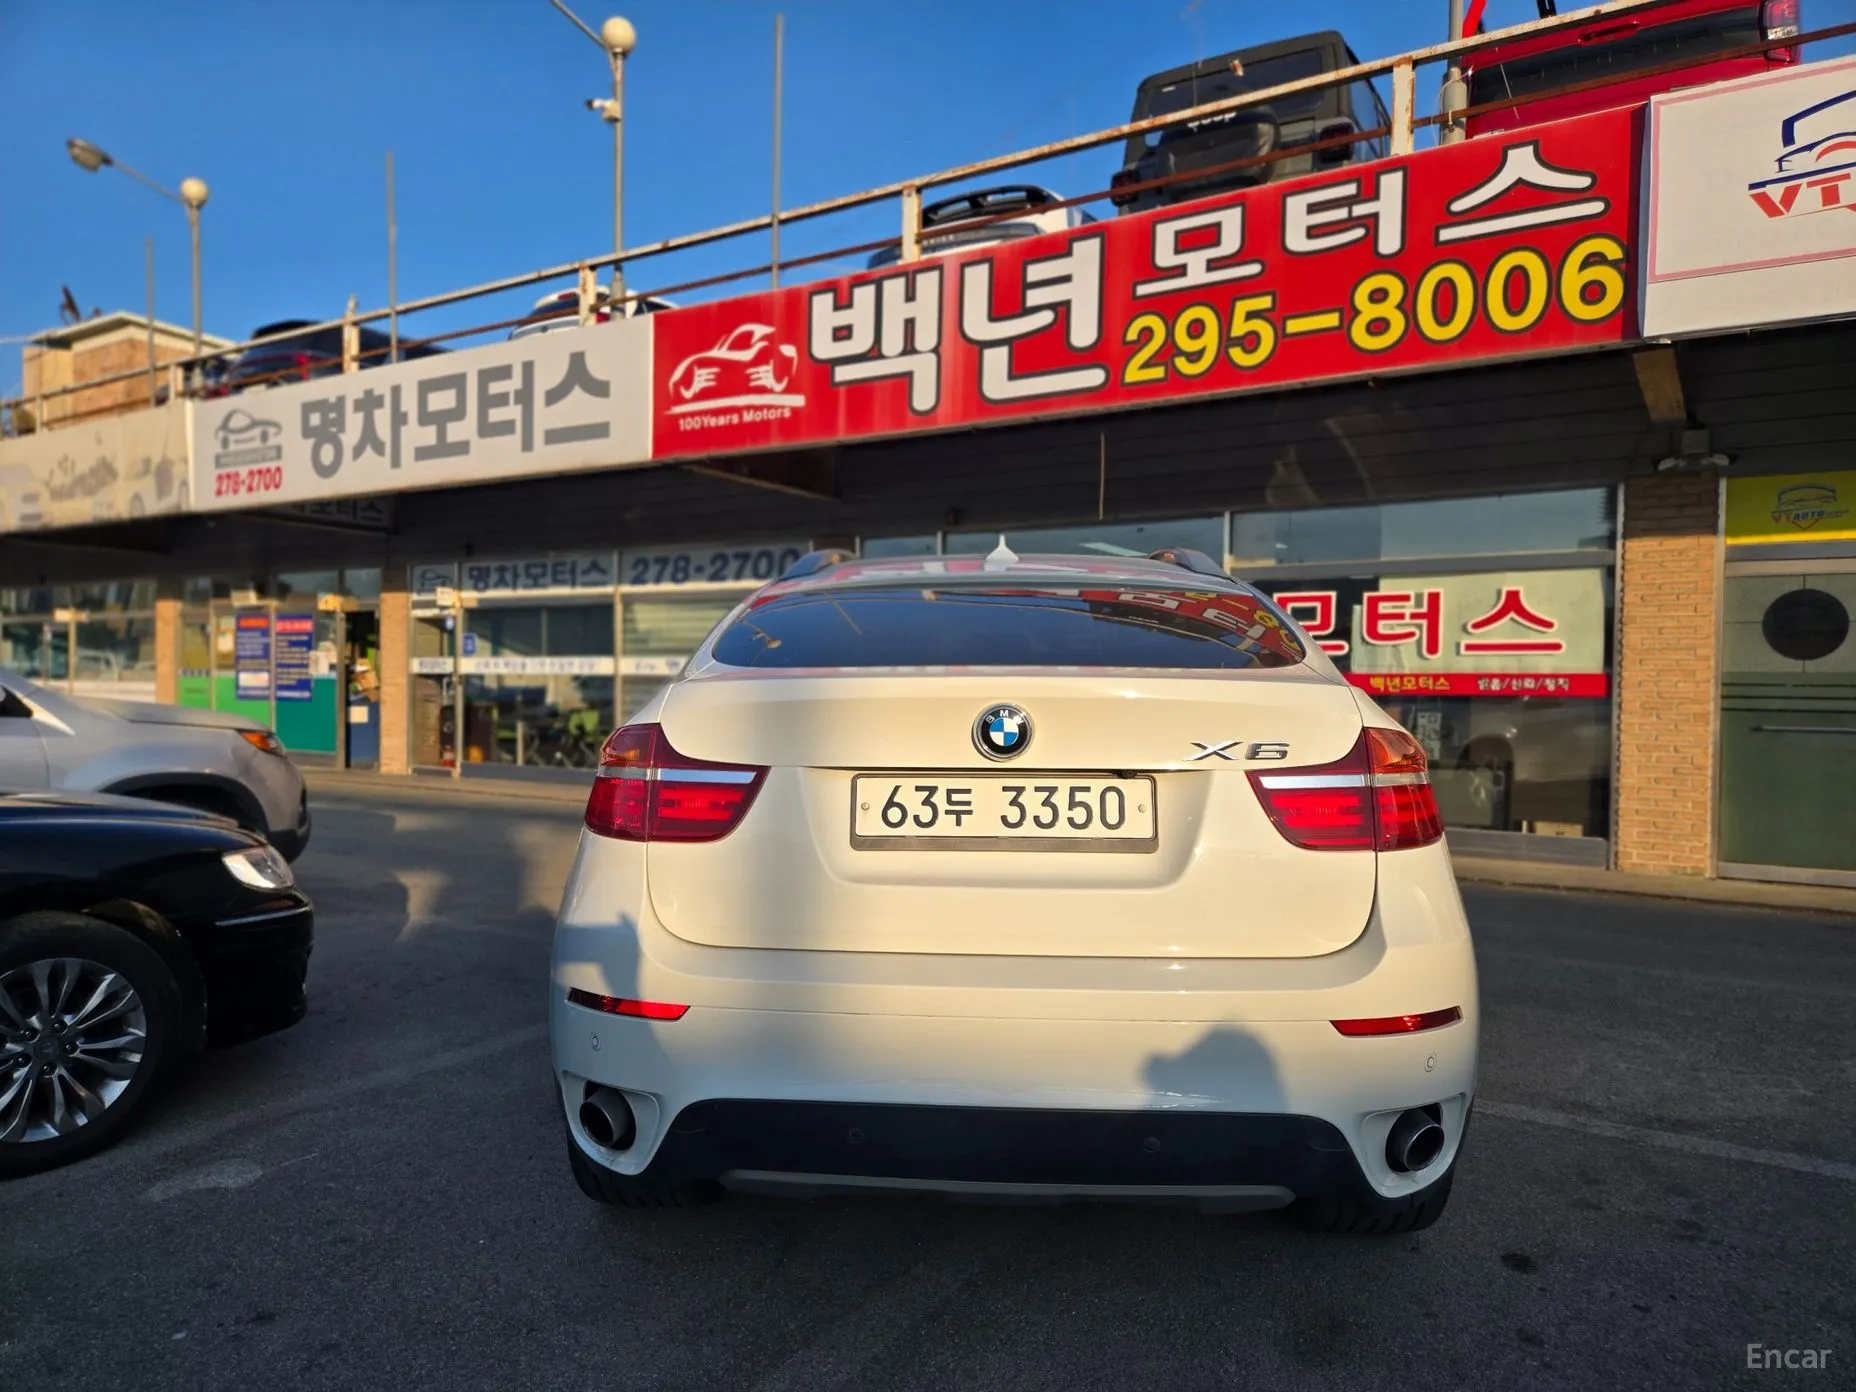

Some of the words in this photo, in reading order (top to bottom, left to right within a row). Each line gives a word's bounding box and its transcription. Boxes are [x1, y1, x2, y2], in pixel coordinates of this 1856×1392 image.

[1120, 233, 1628, 388] 295-8006
[300, 350, 611, 480] 명차모터스
[741, 406, 792, 424] Motors
[468, 558, 608, 592] 명차모터스
[1368, 674, 1451, 691] 백년모터스
[985, 709, 1025, 725] BMW
[1184, 740, 1291, 762] X6
[880, 784, 975, 829] 63두
[1000, 785, 1127, 831] 3350
